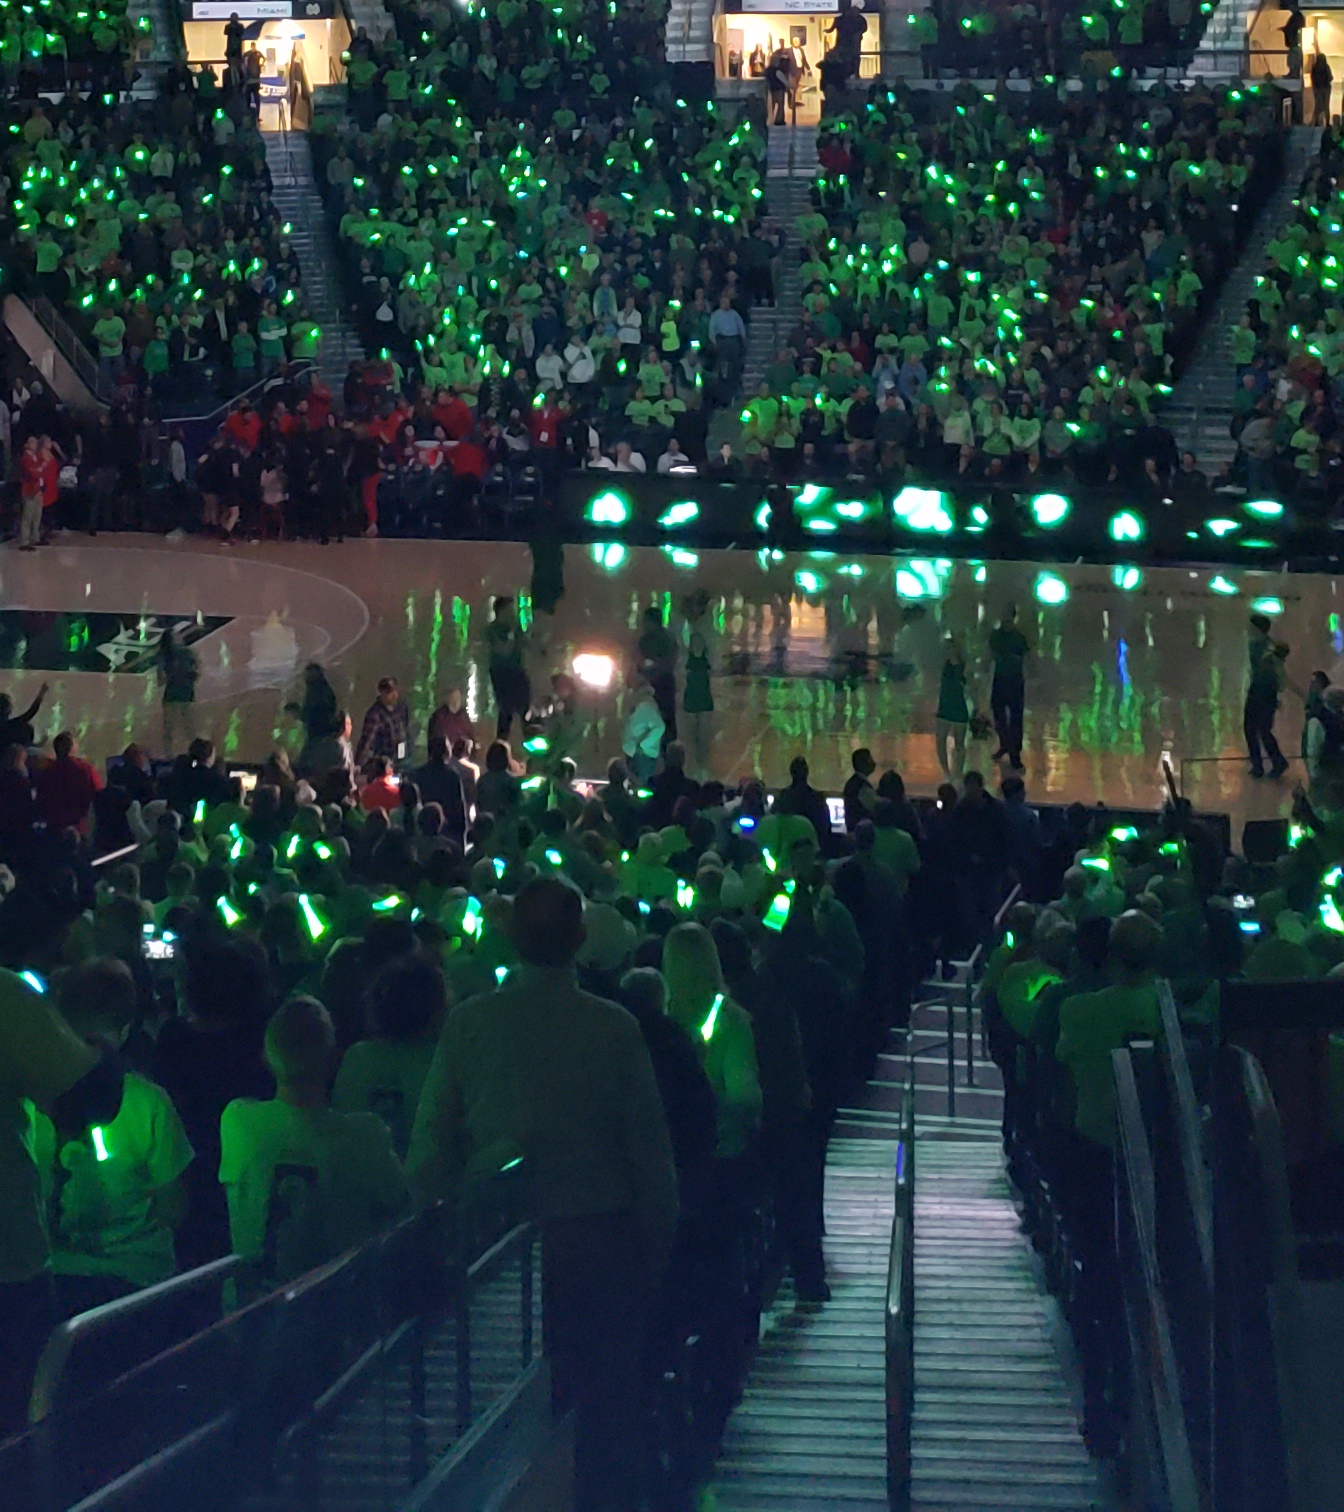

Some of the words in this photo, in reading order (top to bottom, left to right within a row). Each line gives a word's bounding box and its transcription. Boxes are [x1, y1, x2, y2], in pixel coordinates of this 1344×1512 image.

[784, 1, 801, 9] NC
[803, 1, 834, 9] STATE
[256, 7, 288, 15] MIAMI
